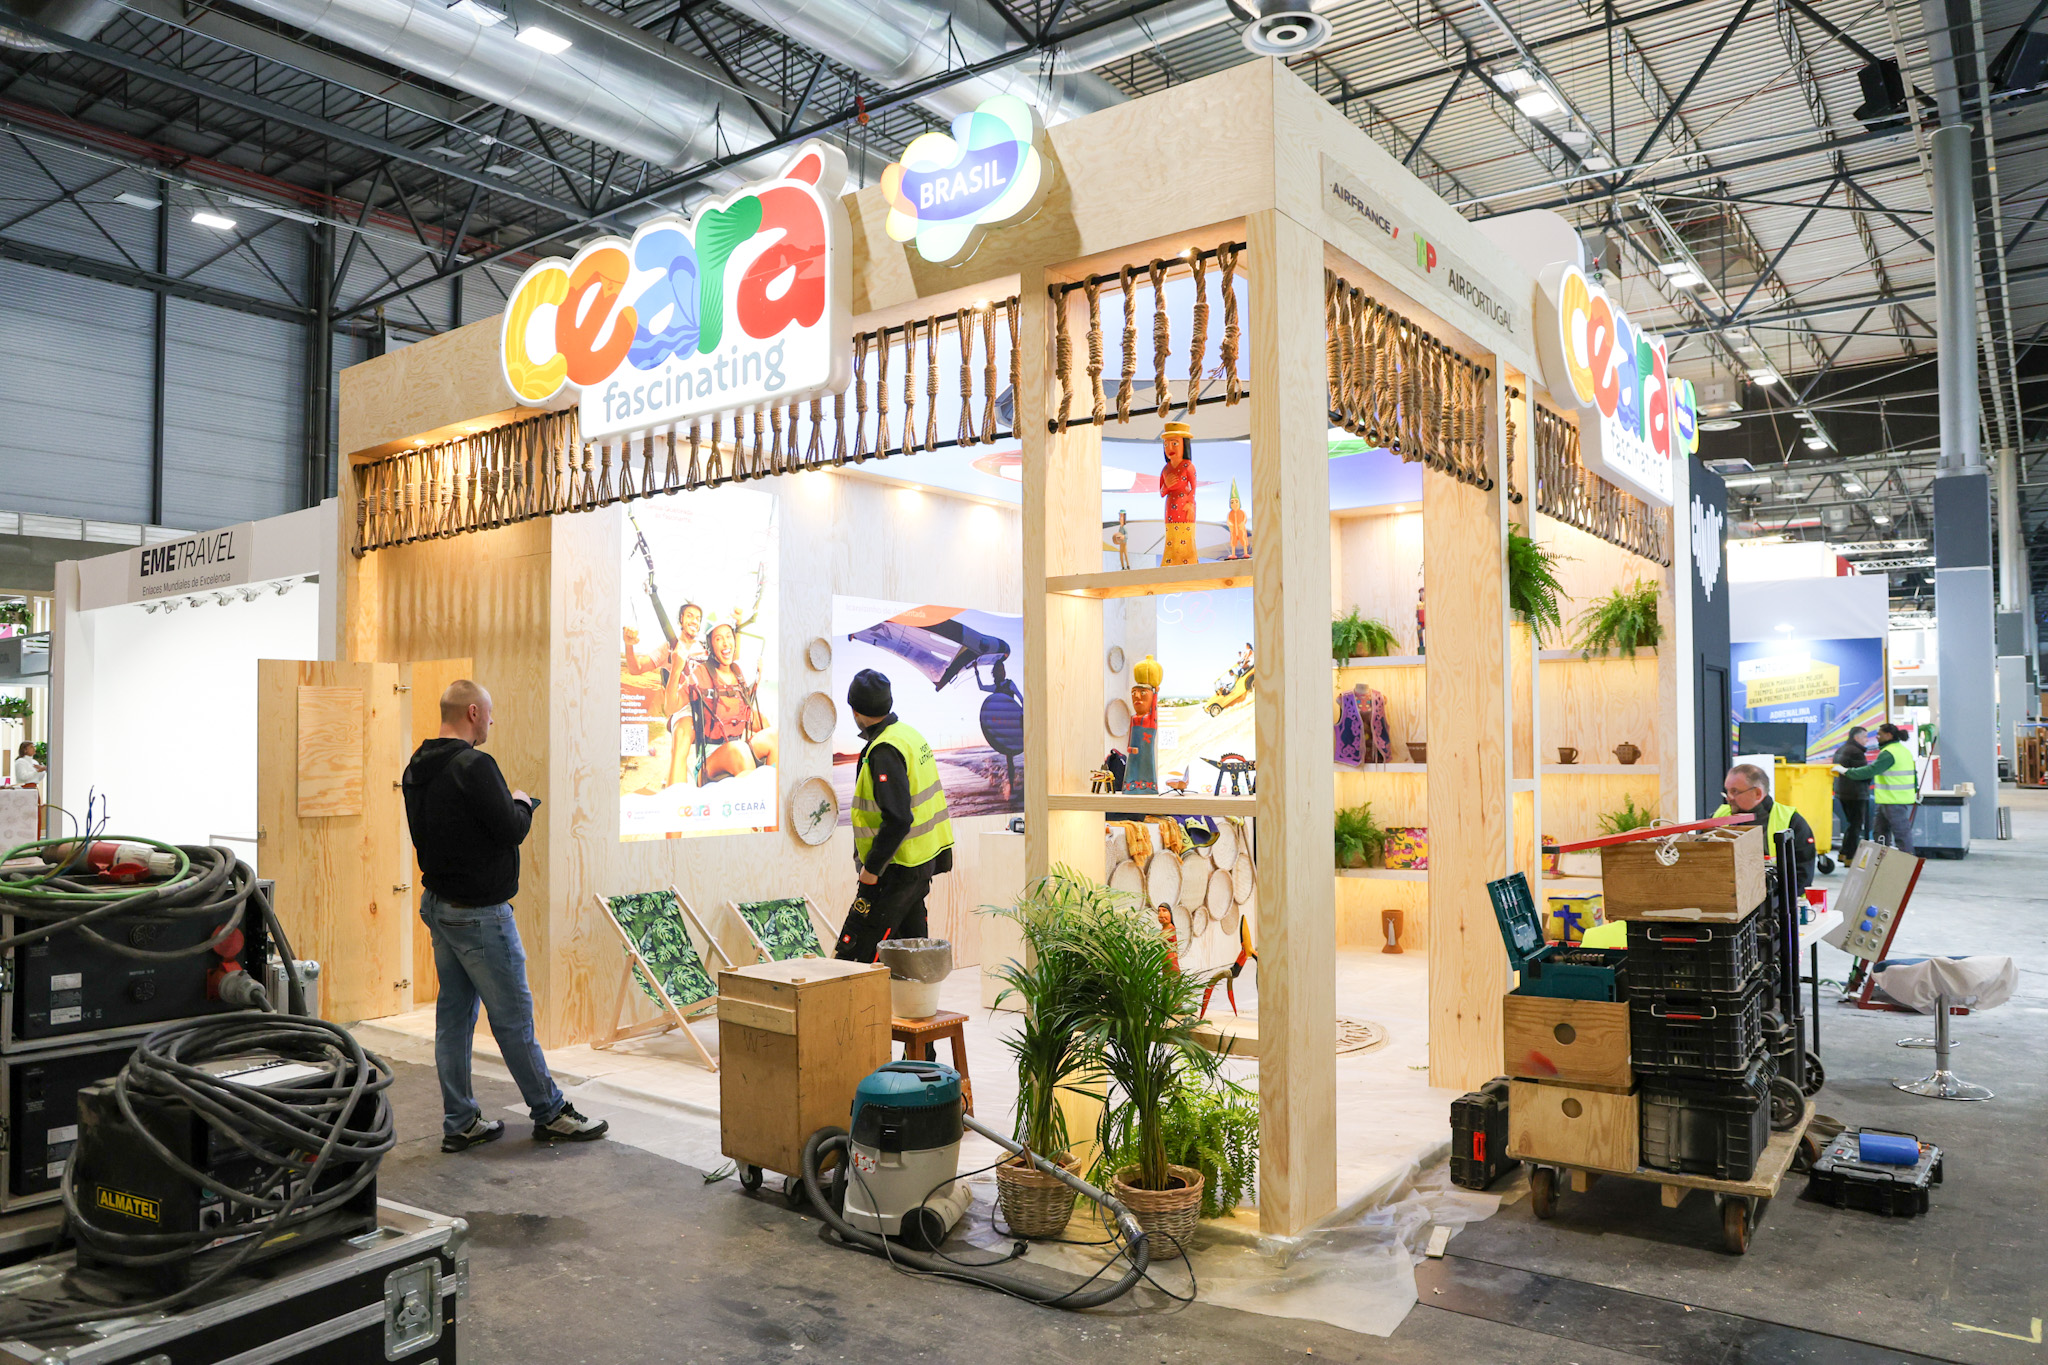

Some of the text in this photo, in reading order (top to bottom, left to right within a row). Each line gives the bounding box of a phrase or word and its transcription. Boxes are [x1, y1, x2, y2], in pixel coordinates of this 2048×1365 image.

[919, 157, 1006, 210] BRASIL
[1333, 182, 1390, 234] AIRFRANCE
[1414, 232, 1437, 273] TAP
[505, 153, 826, 400] ceará
[603, 340, 786, 423] fascinating
[1562, 273, 1670, 460] ceará
[141, 531, 235, 577] EMETRAVEL
[142, 572, 231, 596] Enlaces Mundiales de Excelencia
[621, 707, 648, 715] Instagram
[1770, 707, 1810, 719] ADRENALINA
[735, 800, 766, 811] CEARÁ
[100, 1190, 157, 1219] ALMATEL
